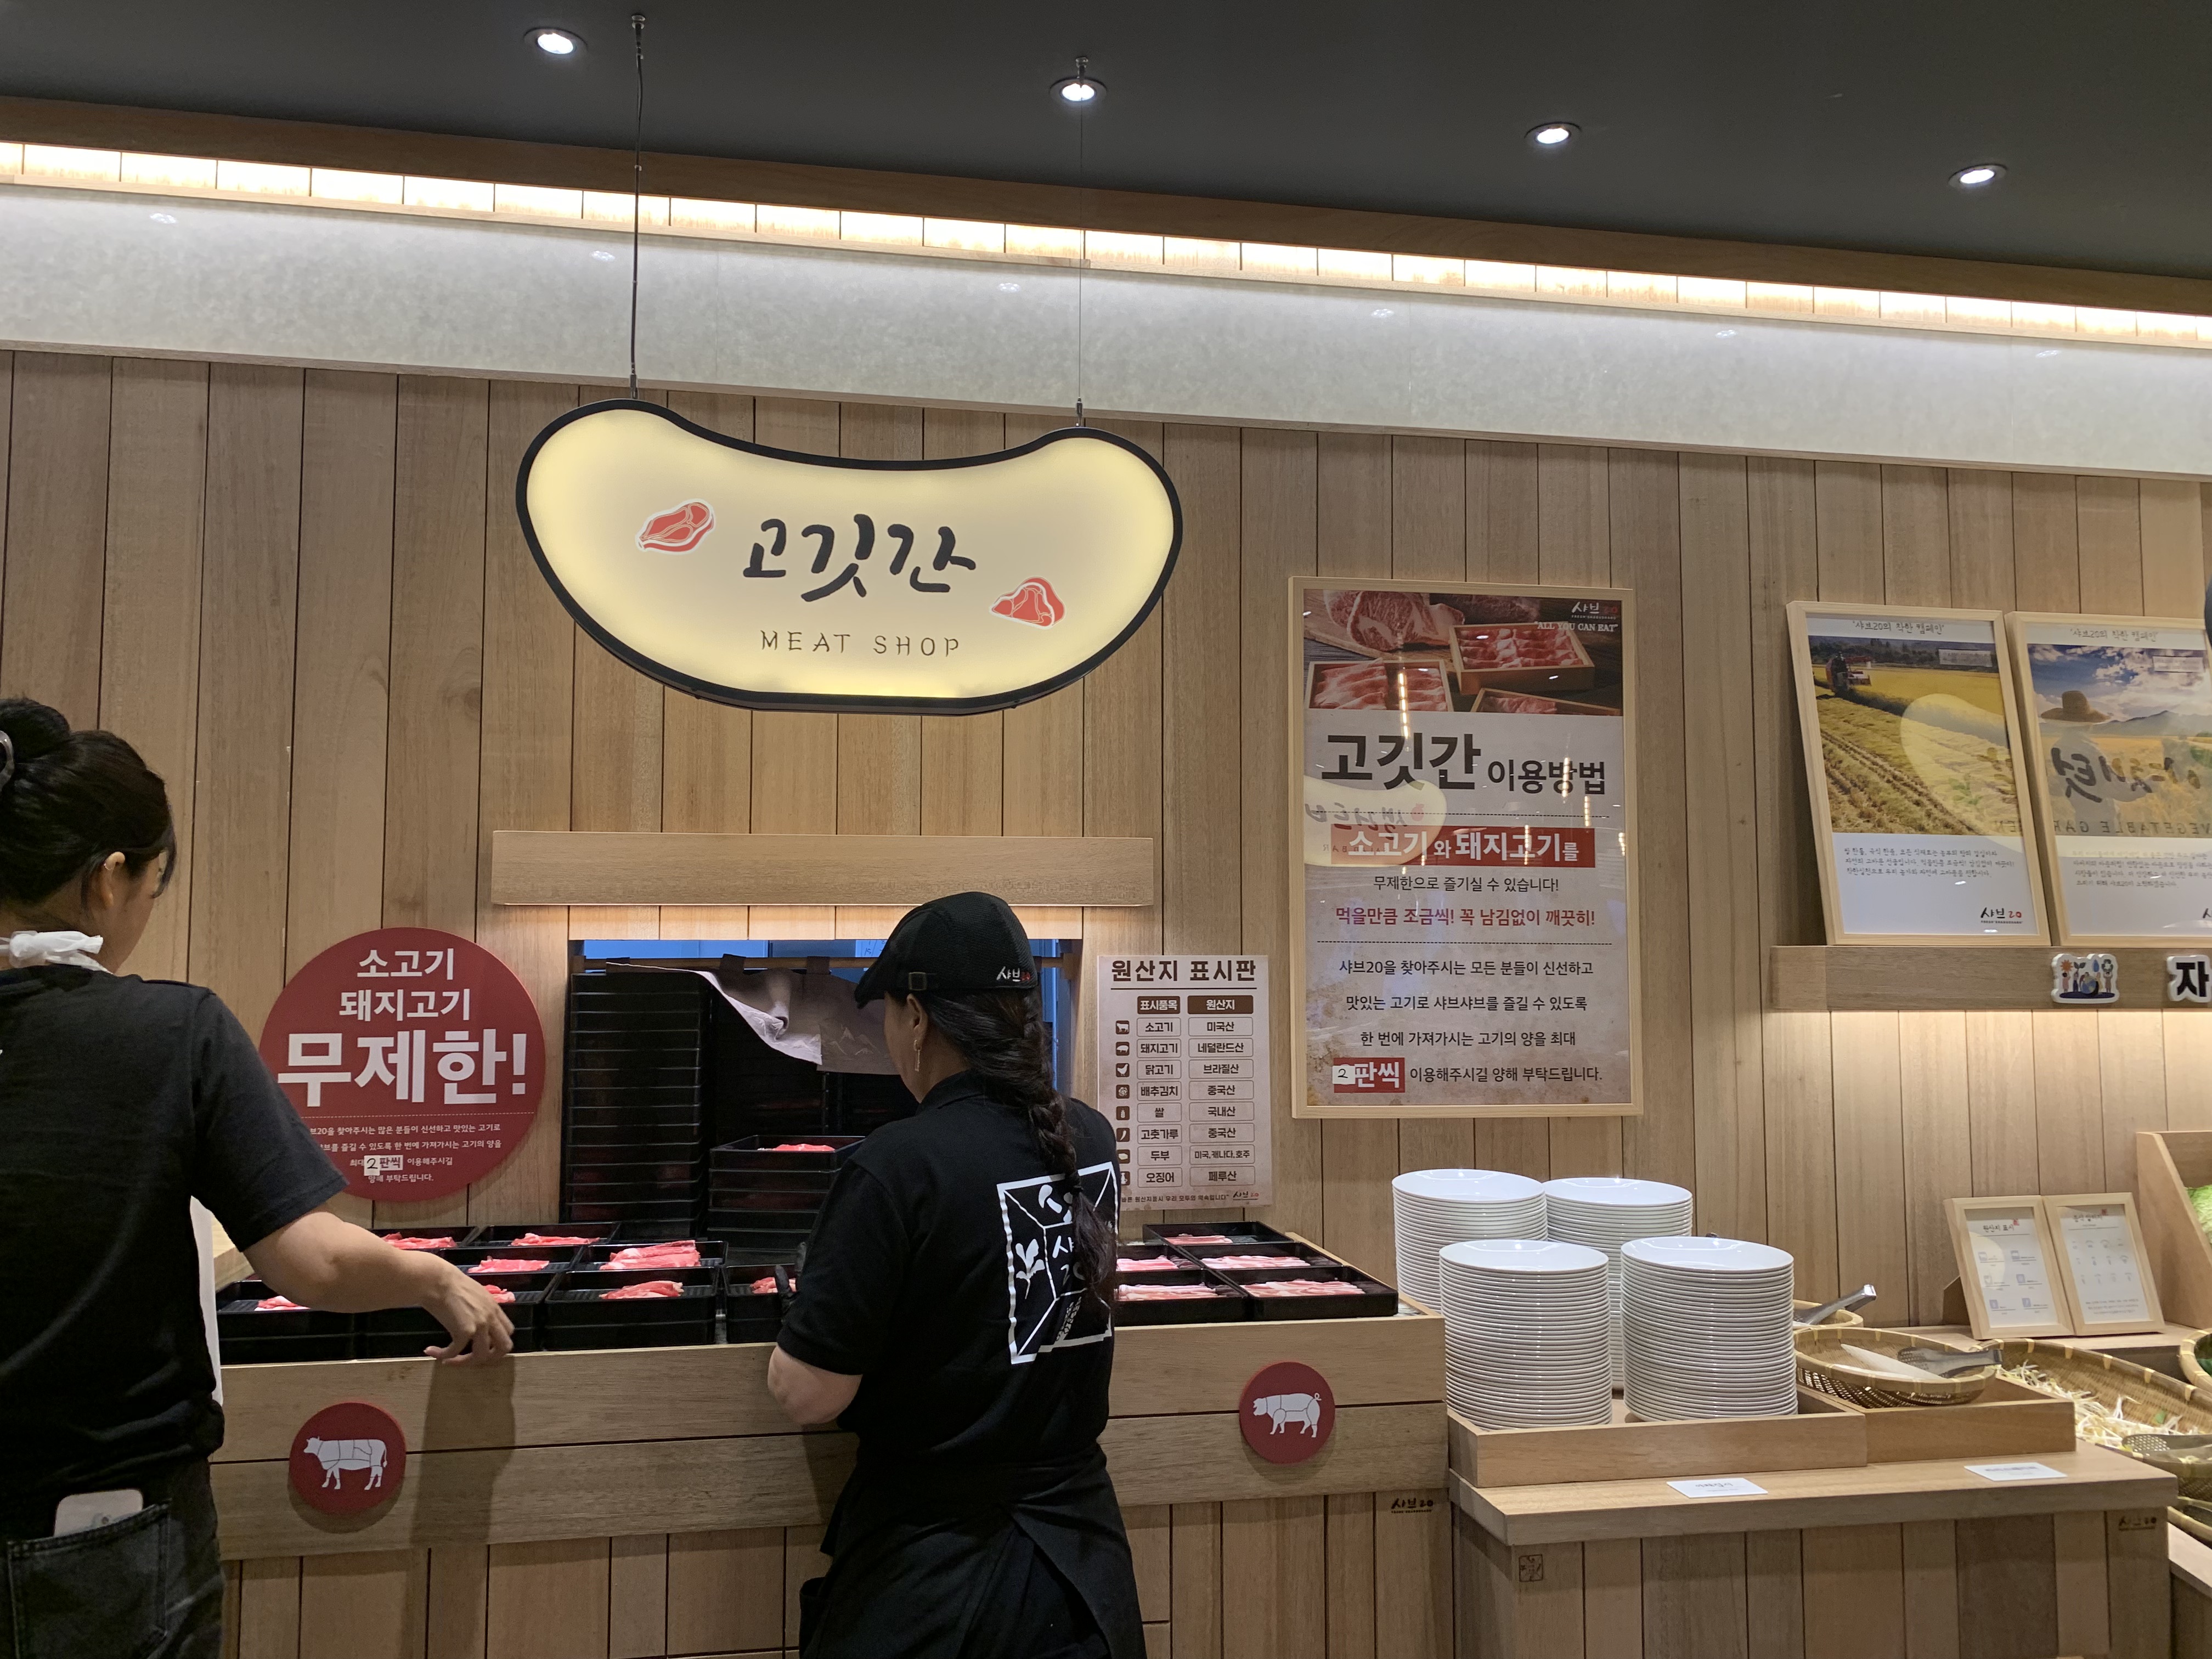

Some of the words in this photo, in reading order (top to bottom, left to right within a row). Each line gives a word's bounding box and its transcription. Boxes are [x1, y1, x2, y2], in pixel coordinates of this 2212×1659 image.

[743, 514, 976, 602] 고깃간
[1896, 622, 1914, 634] 착한
[761, 630, 850, 652] MEAT
[873, 635, 960, 657] SHOP
[1321, 732, 1481, 791] 고깃간
[1488, 760, 1605, 795] 이용방법
[1373, 876, 1439, 891] 무제한으로
[1443, 876, 1482, 893] 즐기실
[1486, 877, 1500, 893] 수
[1504, 877, 1559, 893] 있습니다!
[1335, 907, 1398, 926] 먹을만큼
[1403, 908, 1454, 926] 조금씩!
[1459, 909, 1475, 927] 꼭
[1480, 909, 1541, 927] 남김없이
[1545, 910, 1595, 927] 깨끗히!
[357, 948, 454, 980] 소고기
[1111, 960, 1178, 982] 원산지
[1189, 960, 1256, 981] 표시판
[1339, 960, 1397, 975] 샤브20을
[1401, 960, 1466, 976] 찾아주시는
[1470, 961, 1497, 975] 모든
[1500, 961, 1538, 976] 분들이
[1543, 961, 1594, 975] 신선하고
[2176, 961, 2210, 997] 자
[339, 989, 470, 1022] 돼지고기
[1140, 999, 1178, 1011] 표시품목
[1206, 999, 1235, 1011] 원산지
[1346, 996, 1386, 1011] 맛있는
[1390, 996, 1430, 1010] 고기로
[1434, 996, 1499, 1011] 샤브샤브를
[1503, 996, 1528, 1012] 즐길
[1532, 997, 1546, 1011] 수
[1550, 996, 1588, 1012] 있도록
[1144, 1022, 1173, 1032] 소고기
[1207, 1021, 1234, 1032] 미국산
[1361, 1031, 1374, 1046] 한
[1378, 1031, 1404, 1046] 번에
[1408, 1031, 1474, 1046] 가져가시는
[1478, 1031, 1516, 1046] 고기의
[1520, 1031, 1547, 1046] 양을
[1550, 1031, 1576, 1046] 최대
[1140, 1043, 1178, 1054] 돼지고기
[1197, 1042, 1244, 1053] 네덜란드산
[278, 1028, 527, 1107] 무제한!
[1145, 1064, 1173, 1076] 닭고기
[1203, 1064, 1239, 1075] 브라질산
[1410, 1068, 1488, 1083] 이용해주시길
[1492, 1068, 1519, 1082] 양해
[1522, 1068, 1603, 1082] 부탁드립니다.
[1141, 1086, 1178, 1097] 배추김치
[1207, 1085, 1235, 1096] 중국산
[1155, 1107, 1165, 1118] 쌀
[1207, 1106, 1236, 1117] 국내산
[310, 1127, 334, 1136] 브20을
[337, 1126, 376, 1136] 찾아주시는
[378, 1126, 393, 1135] 많은
[396, 1125, 419, 1135] 분들이
[421, 1125, 452, 1134] 신선하고
[453, 1124, 476, 1133] 맛있는
[1141, 1128, 1179, 1140] 고춧가루
[1208, 1127, 1236, 1138] 중국산
[359, 1143, 367, 1151] 수
[369, 1142, 392, 1151] 있도록
[394, 1142, 402, 1150] 한
[404, 1142, 419, 1150] 번에
[462, 1140, 484, 1148] 고기의
[486, 1139, 502, 1148] 양을
[407, 1156, 453, 1166] 이용해주시길
[1150, 1150, 1170, 1161] 두부
[386, 1173, 434, 1183] 부탁드립니다.
[1146, 1172, 1175, 1183] 오징어
[1209, 1171, 1237, 1182] 페루산
